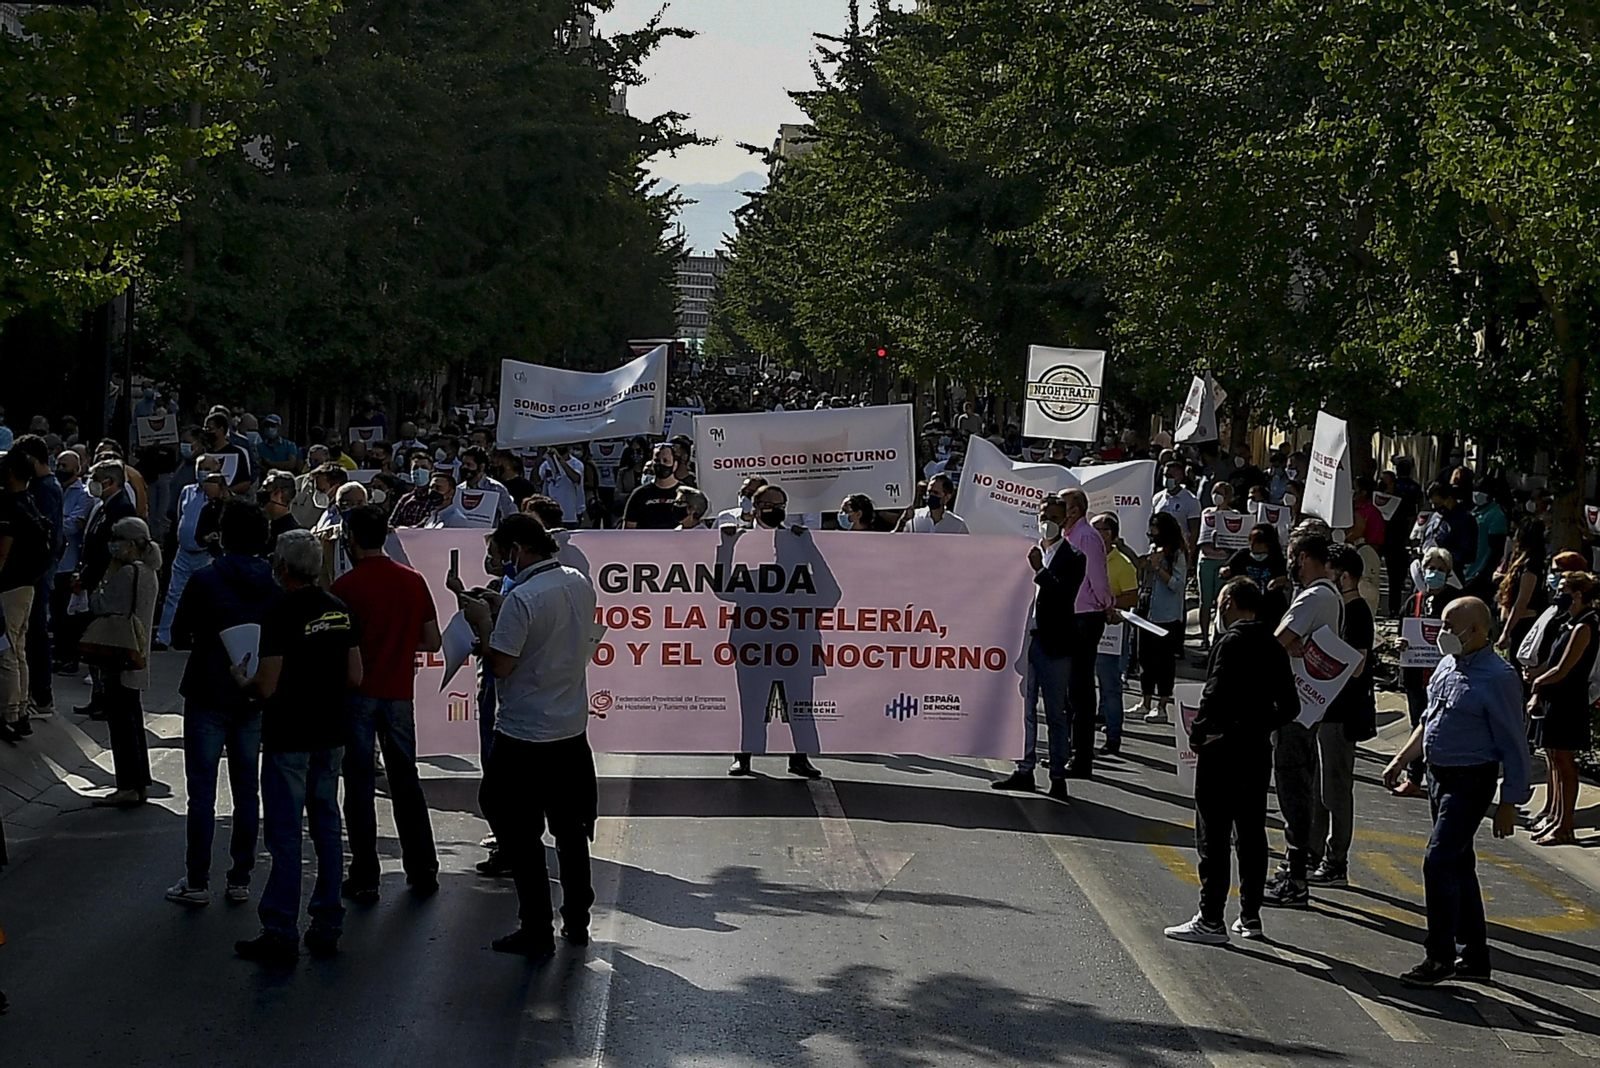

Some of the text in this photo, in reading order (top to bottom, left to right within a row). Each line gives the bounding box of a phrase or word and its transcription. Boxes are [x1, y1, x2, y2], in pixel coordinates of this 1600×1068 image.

[514, 382, 656, 413] SOMOS OCIO NOCTURNO
[713, 449, 896, 469] SOMOS OCIO NOCTURNO
[972, 473, 992, 487] NO
[996, 480, 1044, 499] SOMOS
[989, 492, 1019, 506] SOMOS
[599, 563, 816, 594] GRANADA
[664, 606, 706, 629] LA
[718, 603, 948, 639] HOSTELERÍA,
[627, 643, 650, 666] Y
[661, 643, 702, 666] EL
[714, 643, 799, 667] OCIO
[812, 644, 1006, 671] NOCTURNO
[924, 694, 960, 703] ESPAÑA
[1303, 684, 1326, 704] SUMO
